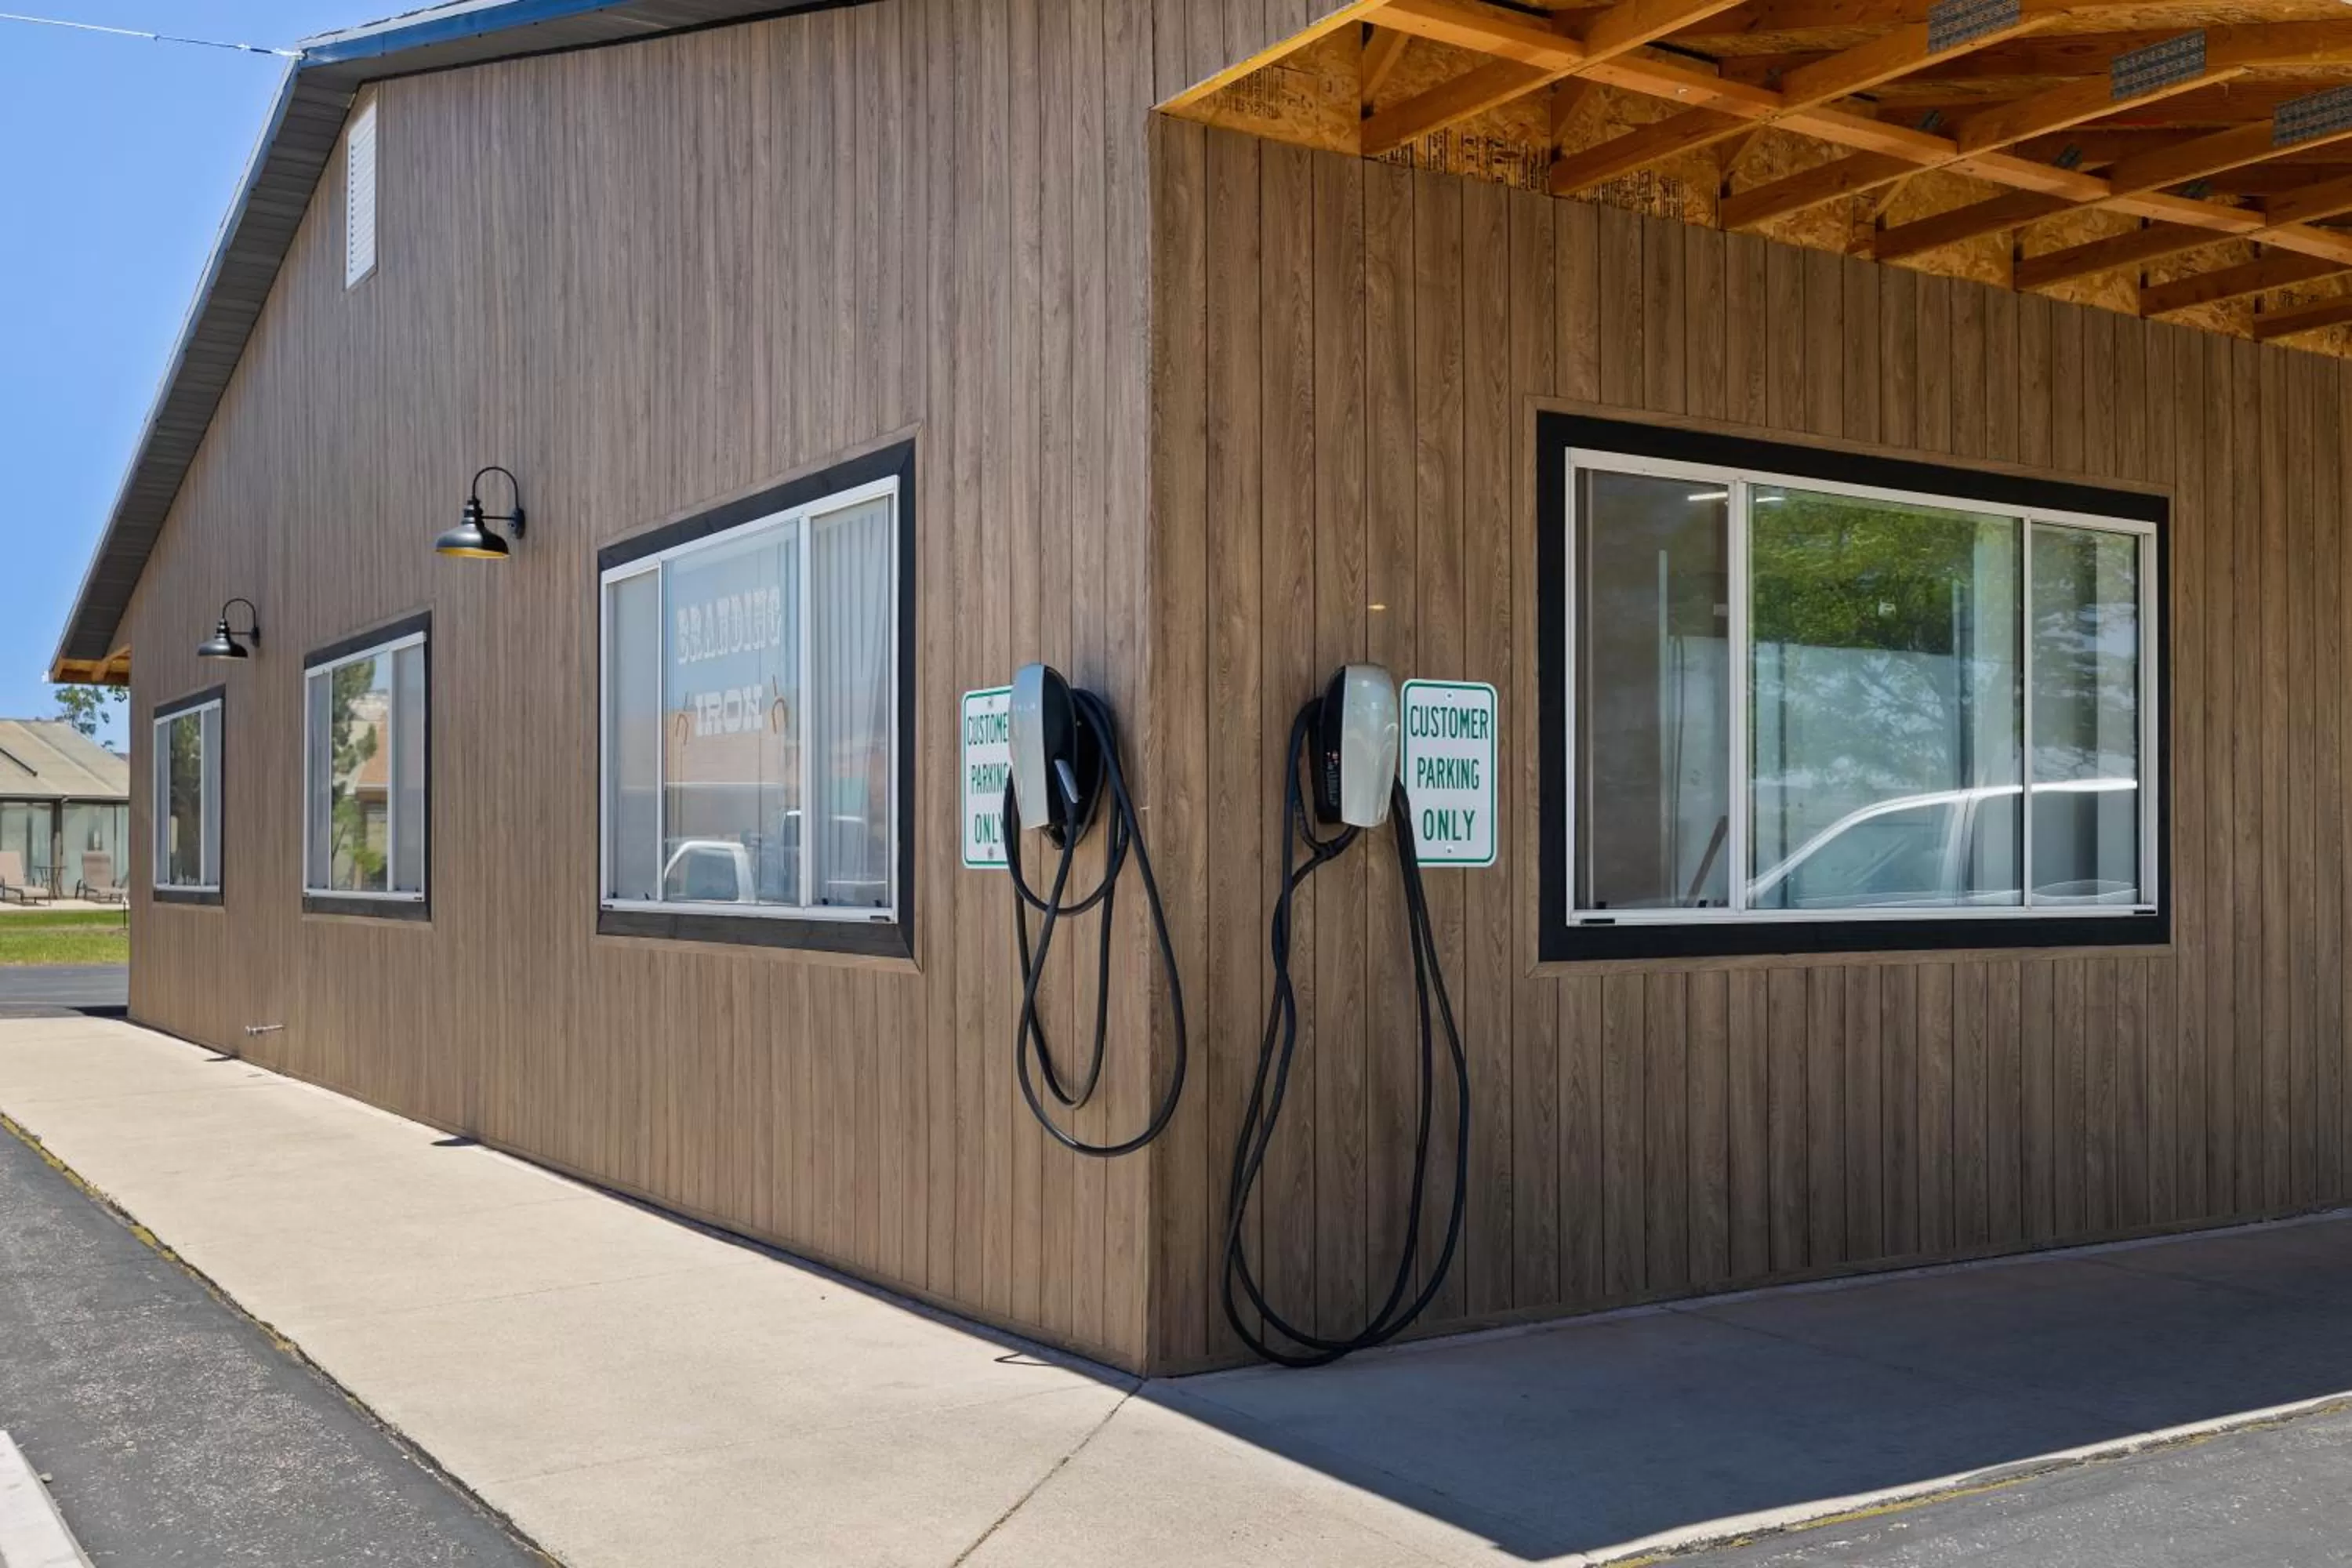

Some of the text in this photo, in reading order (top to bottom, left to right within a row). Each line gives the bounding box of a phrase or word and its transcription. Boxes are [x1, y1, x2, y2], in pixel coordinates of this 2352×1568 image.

[677, 586, 781, 665] BRANDING
[695, 684, 763, 737] IRON
[1410, 706, 1489, 739] CUSTOMER
[967, 712, 1008, 745] CUSTOME
[1417, 757, 1479, 790] PARKING
[1423, 809, 1475, 841] ONLY
